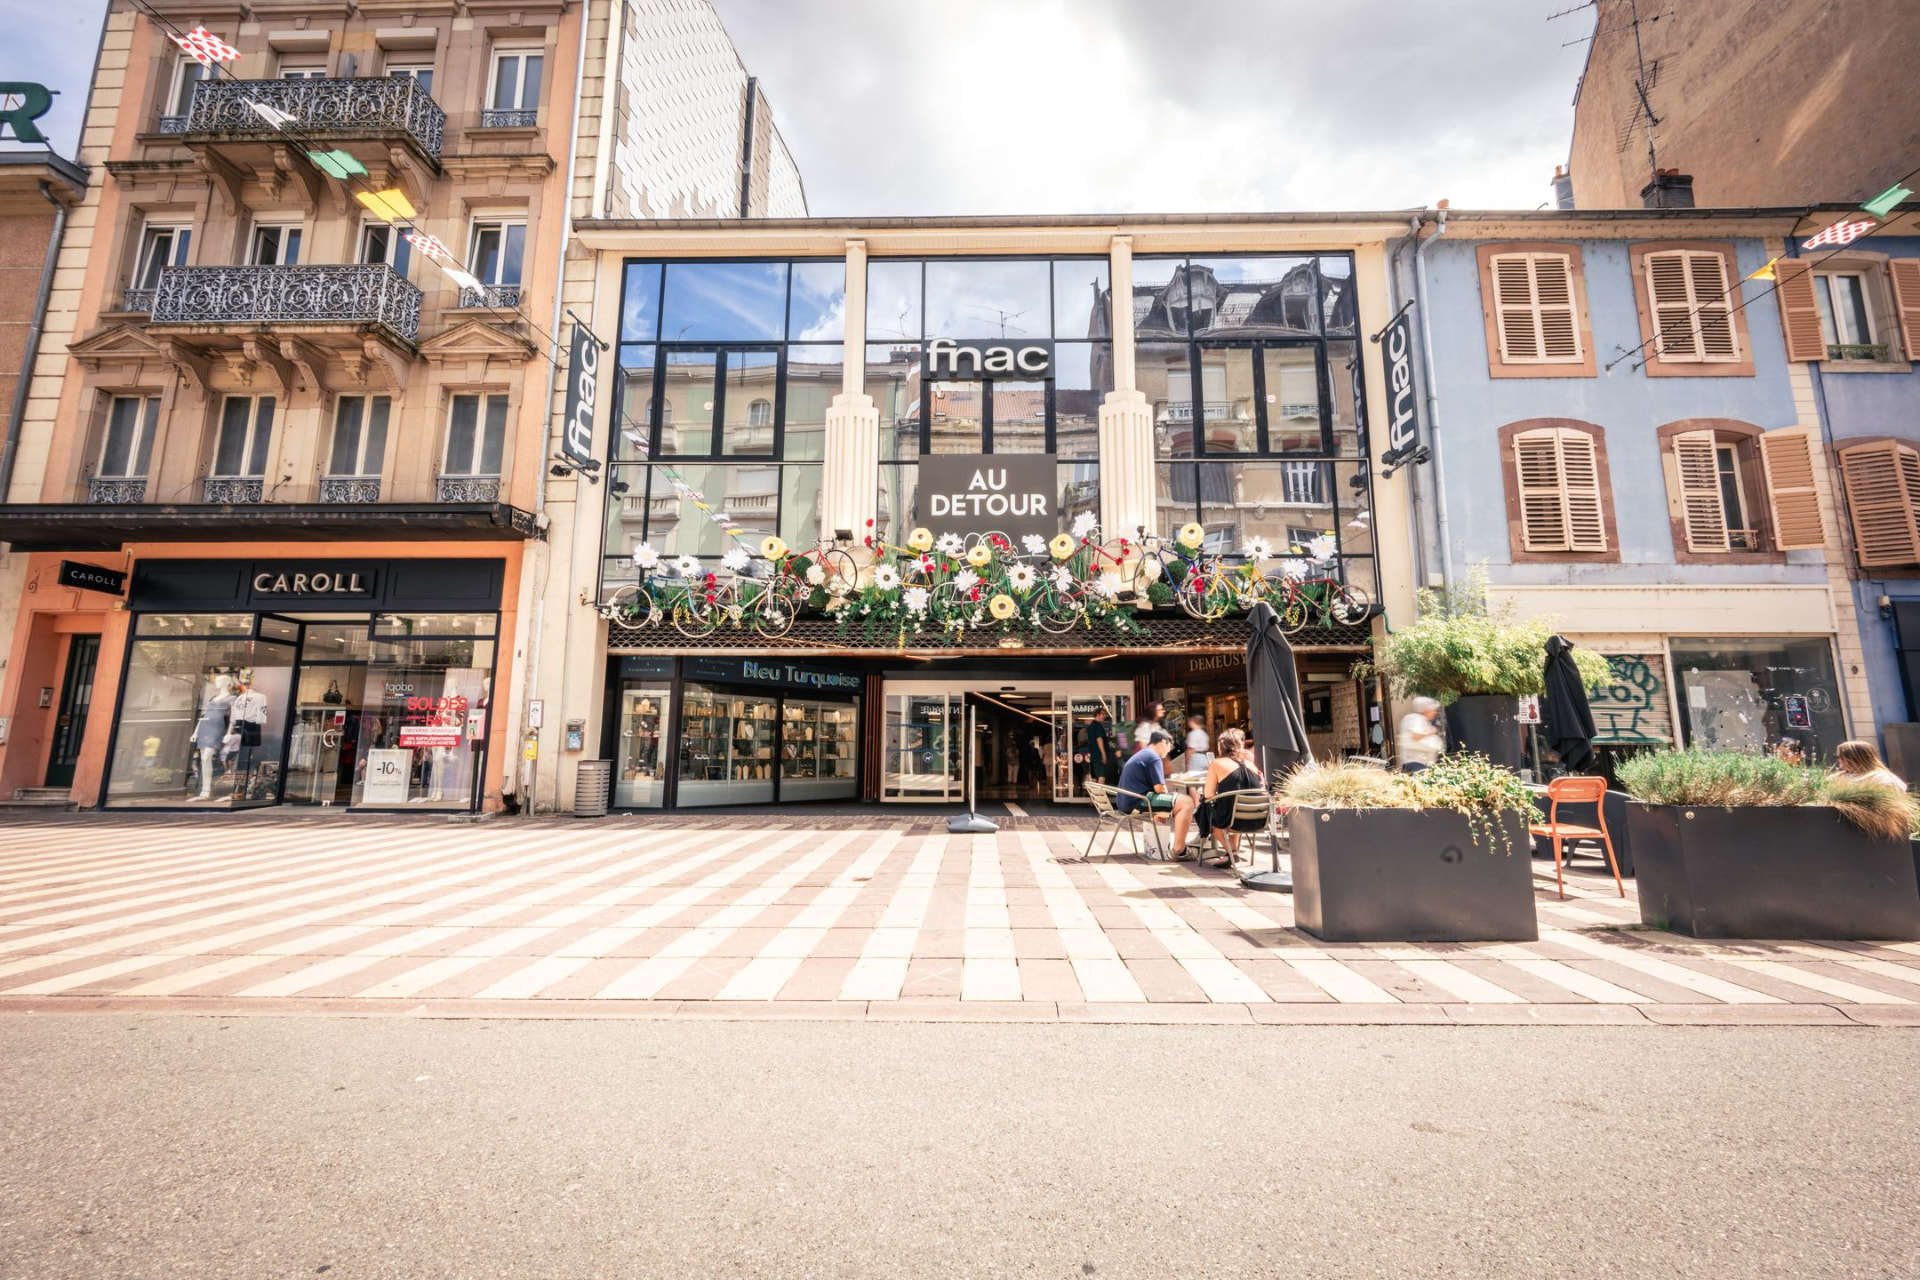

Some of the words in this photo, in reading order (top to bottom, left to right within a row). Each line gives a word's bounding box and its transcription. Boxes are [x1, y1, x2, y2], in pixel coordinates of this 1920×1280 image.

[926, 338, 1049, 374] fnac
[568, 340, 598, 458] fnac
[1390, 325, 1415, 451] fnac
[968, 468, 1007, 490] AU
[931, 494, 1048, 516] DETOUR
[70, 570, 117, 586] CAROLL
[253, 572, 366, 593] CAROLL
[1189, 651, 1248, 671] DEMEUSY
[743, 660, 780, 680] Bleu
[784, 665, 860, 688] Turquoise
[407, 696, 468, 711] SOLDES
[376, 761, 402, 775] -10%
